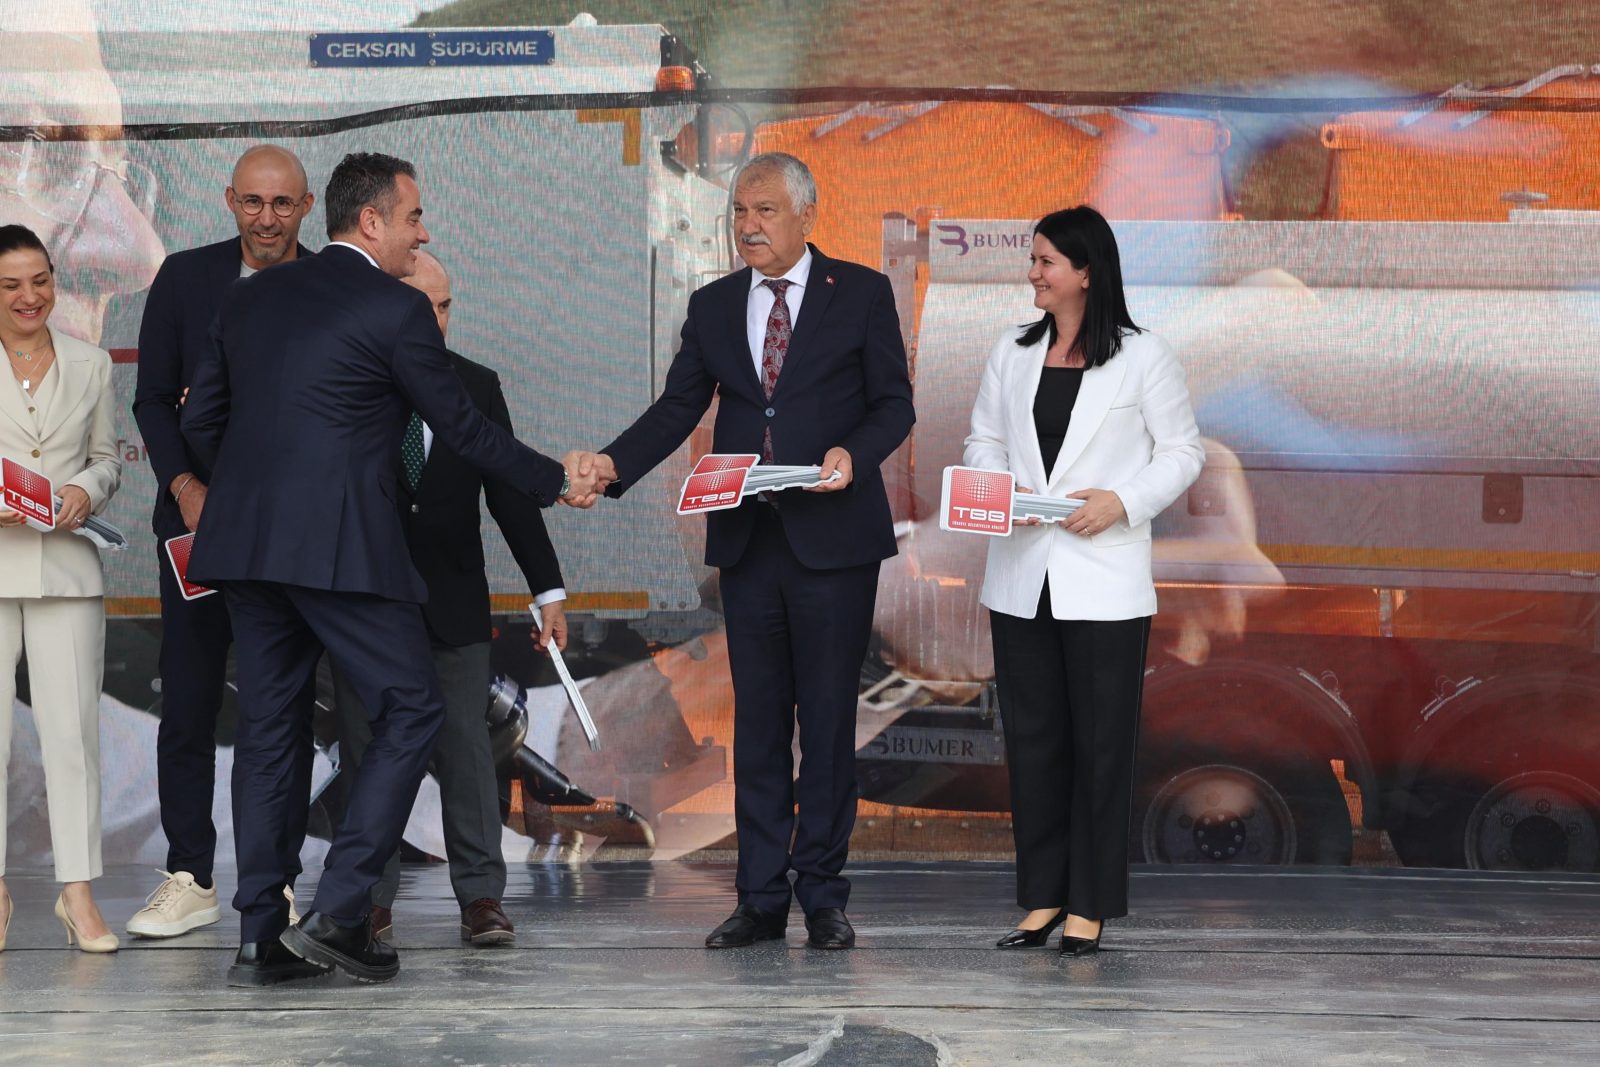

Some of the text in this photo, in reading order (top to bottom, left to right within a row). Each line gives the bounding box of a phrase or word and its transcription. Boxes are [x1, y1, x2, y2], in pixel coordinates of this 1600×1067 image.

[431, 41, 538, 57] SÜPÜRME
[973, 233, 1031, 248] BUME
[6, 488, 50, 517] TBB
[686, 491, 736, 504] TBB
[952, 506, 1006, 523] TBB
[892, 737, 974, 757] BUMER
